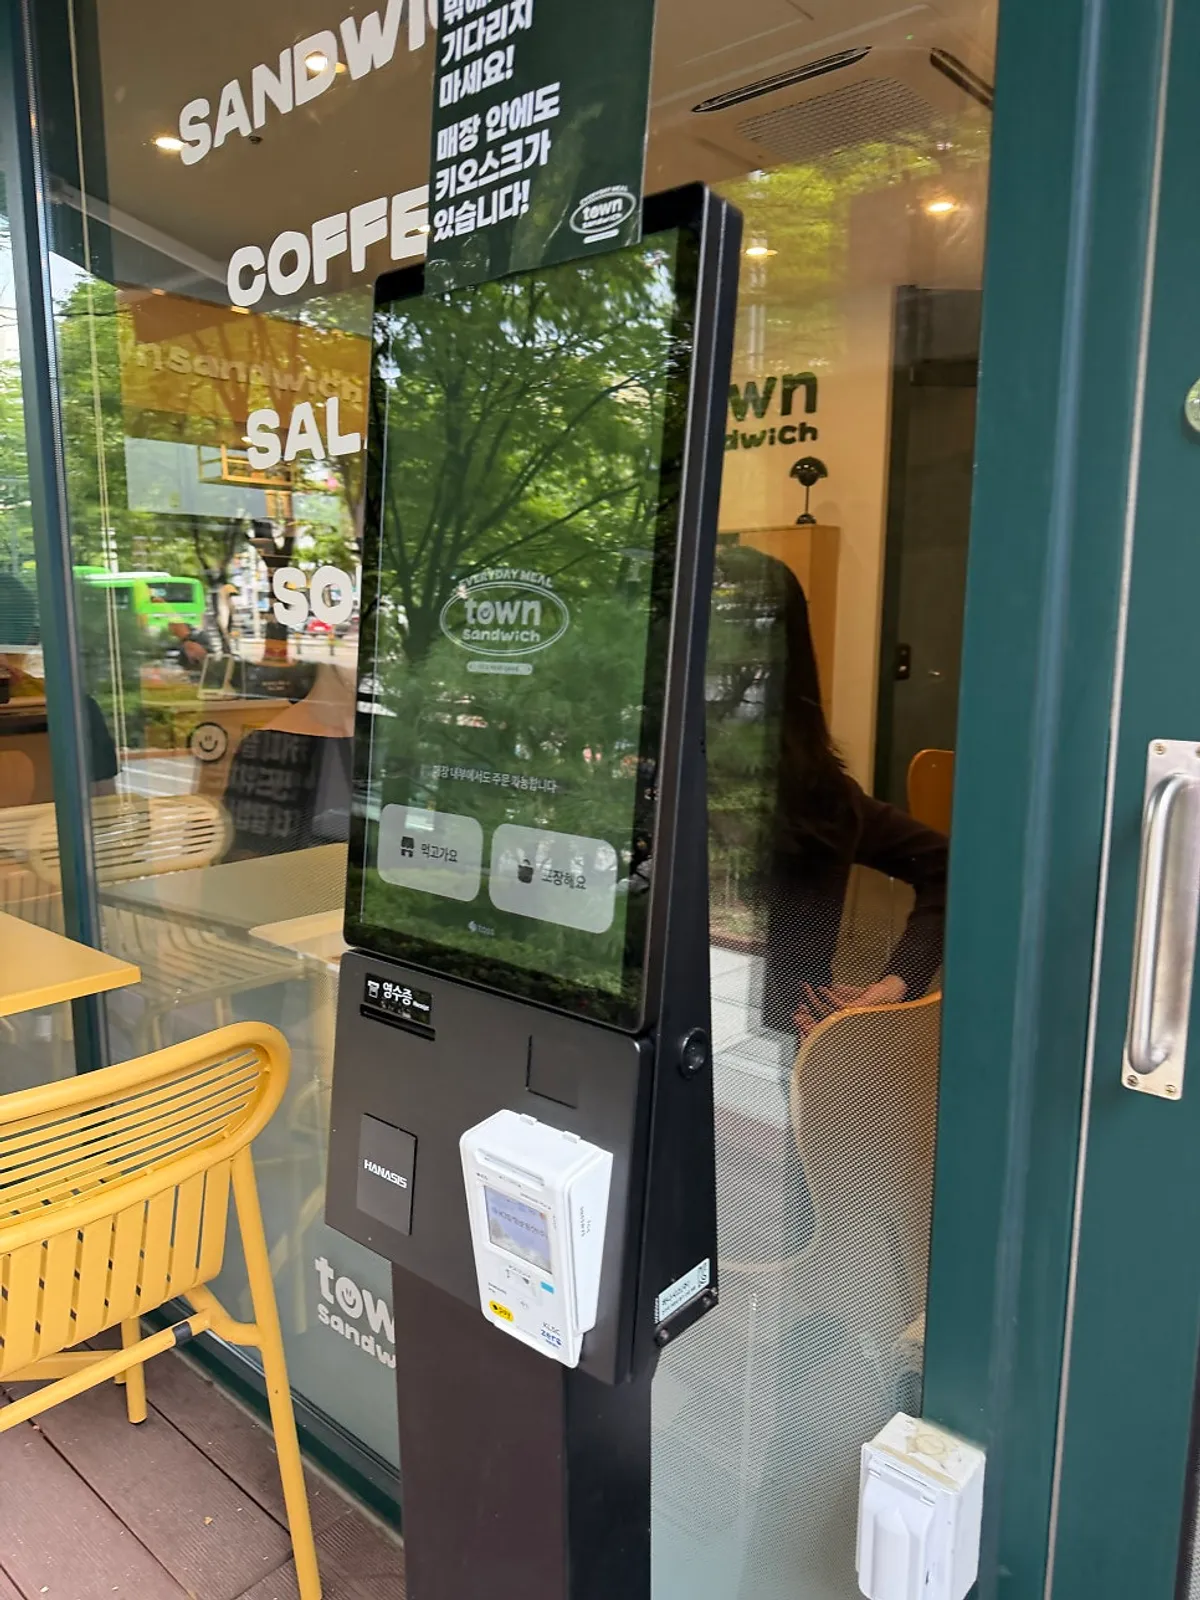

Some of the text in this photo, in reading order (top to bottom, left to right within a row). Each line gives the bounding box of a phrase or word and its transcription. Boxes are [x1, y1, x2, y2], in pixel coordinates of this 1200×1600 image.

[441, 0, 533, 67] 기다리지
[439, 45, 515, 108] 마세요!
[436, 81, 561, 161] 매장 안에도
[435, 128, 552, 202] 키오스크가
[433, 179, 531, 243] 있습니다!
[246, 396, 367, 470] SAL
[273, 565, 362, 628] SO
[520, 570, 553, 589] MEAL
[462, 628, 540, 642] sandwich
[464, 598, 543, 626] town
[420, 843, 458, 863] 먹고가요
[382, 981, 413, 1006] 영수증
[363, 1158, 408, 1189] HANASIS
